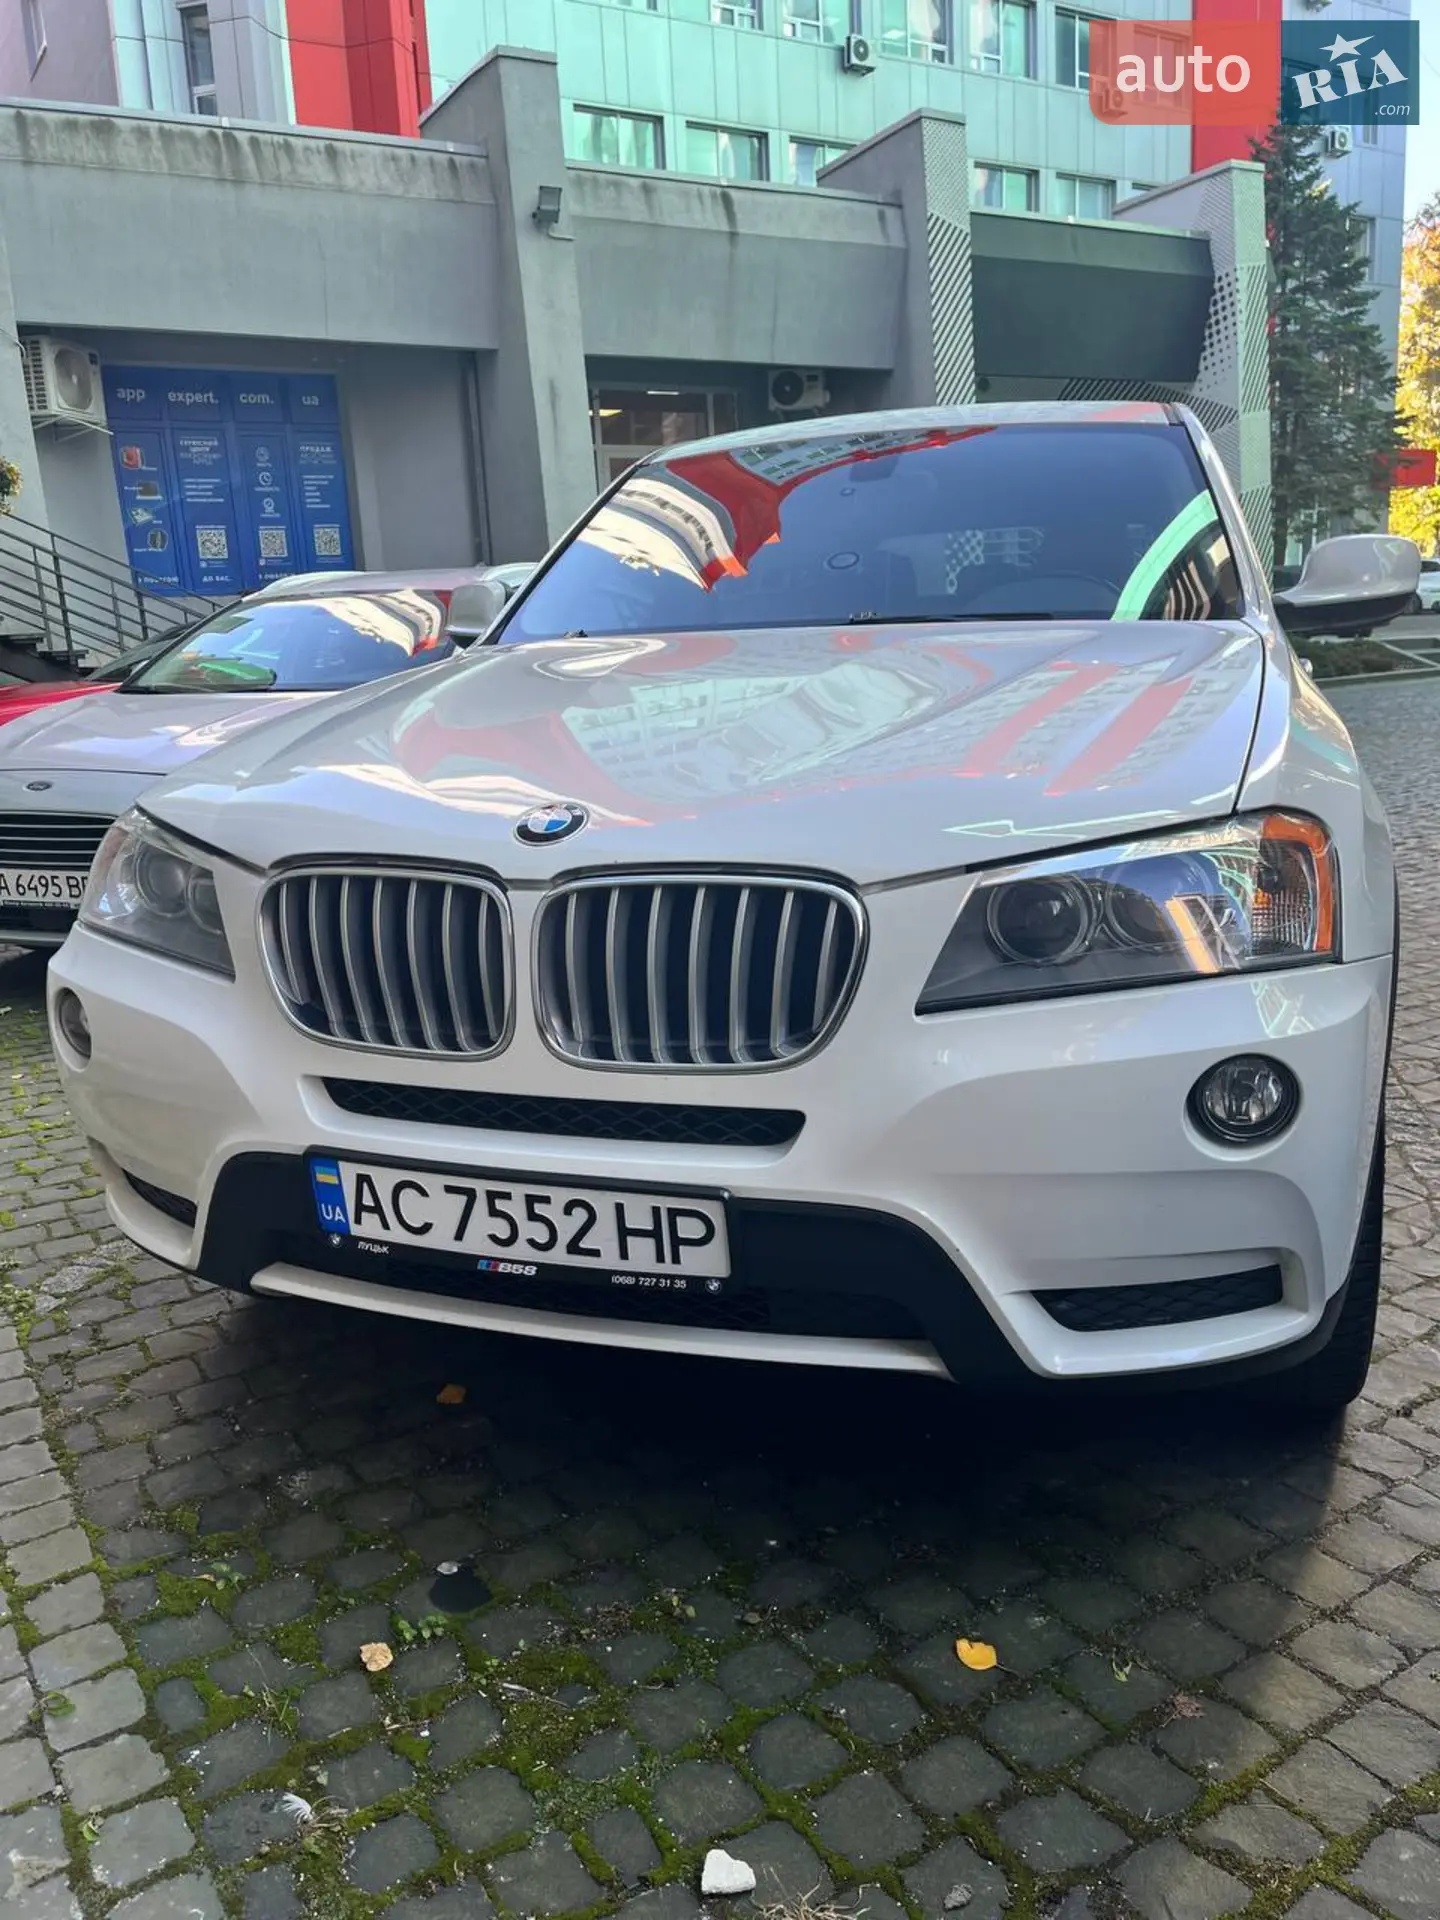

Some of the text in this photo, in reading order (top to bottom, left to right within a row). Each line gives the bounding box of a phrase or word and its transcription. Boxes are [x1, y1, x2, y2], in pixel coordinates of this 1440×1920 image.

[117, 387, 319, 406] app expert. com. ua
[16, 874, 62, 898] 6495
[321, 1203, 346, 1223] UA
[354, 1173, 716, 1265] AC 7552 HP
[611, 1274, 687, 1289] (068) 727 31 35
